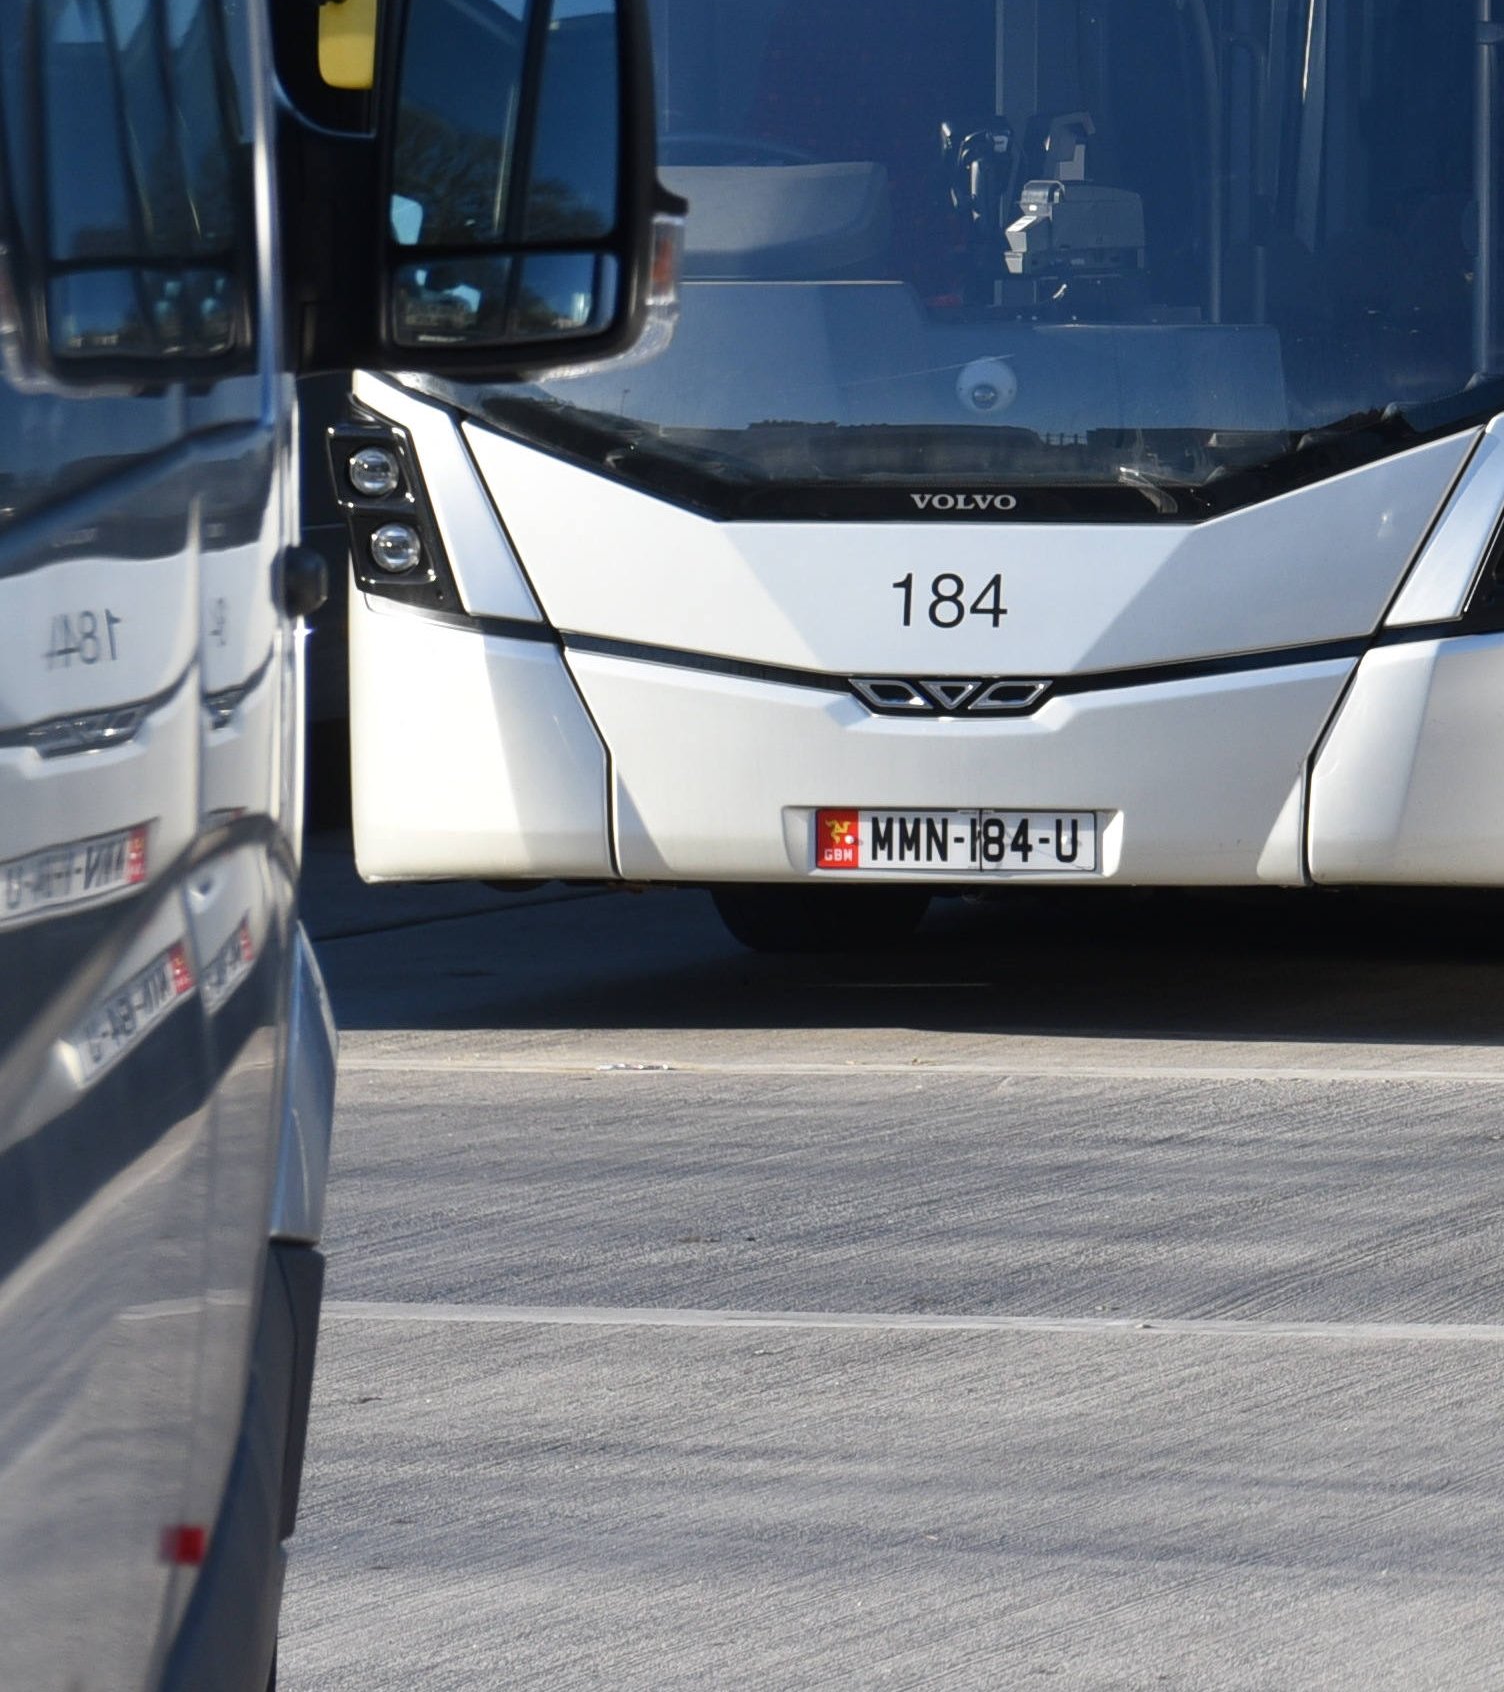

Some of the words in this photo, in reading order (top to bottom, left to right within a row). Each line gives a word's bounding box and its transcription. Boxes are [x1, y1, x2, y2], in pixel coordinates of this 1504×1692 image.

[909, 493, 1017, 511] VOLVO
[892, 572, 1009, 630] 184
[823, 847, 853, 863] GBM
[871, 817, 1080, 864] MMN-184-U
